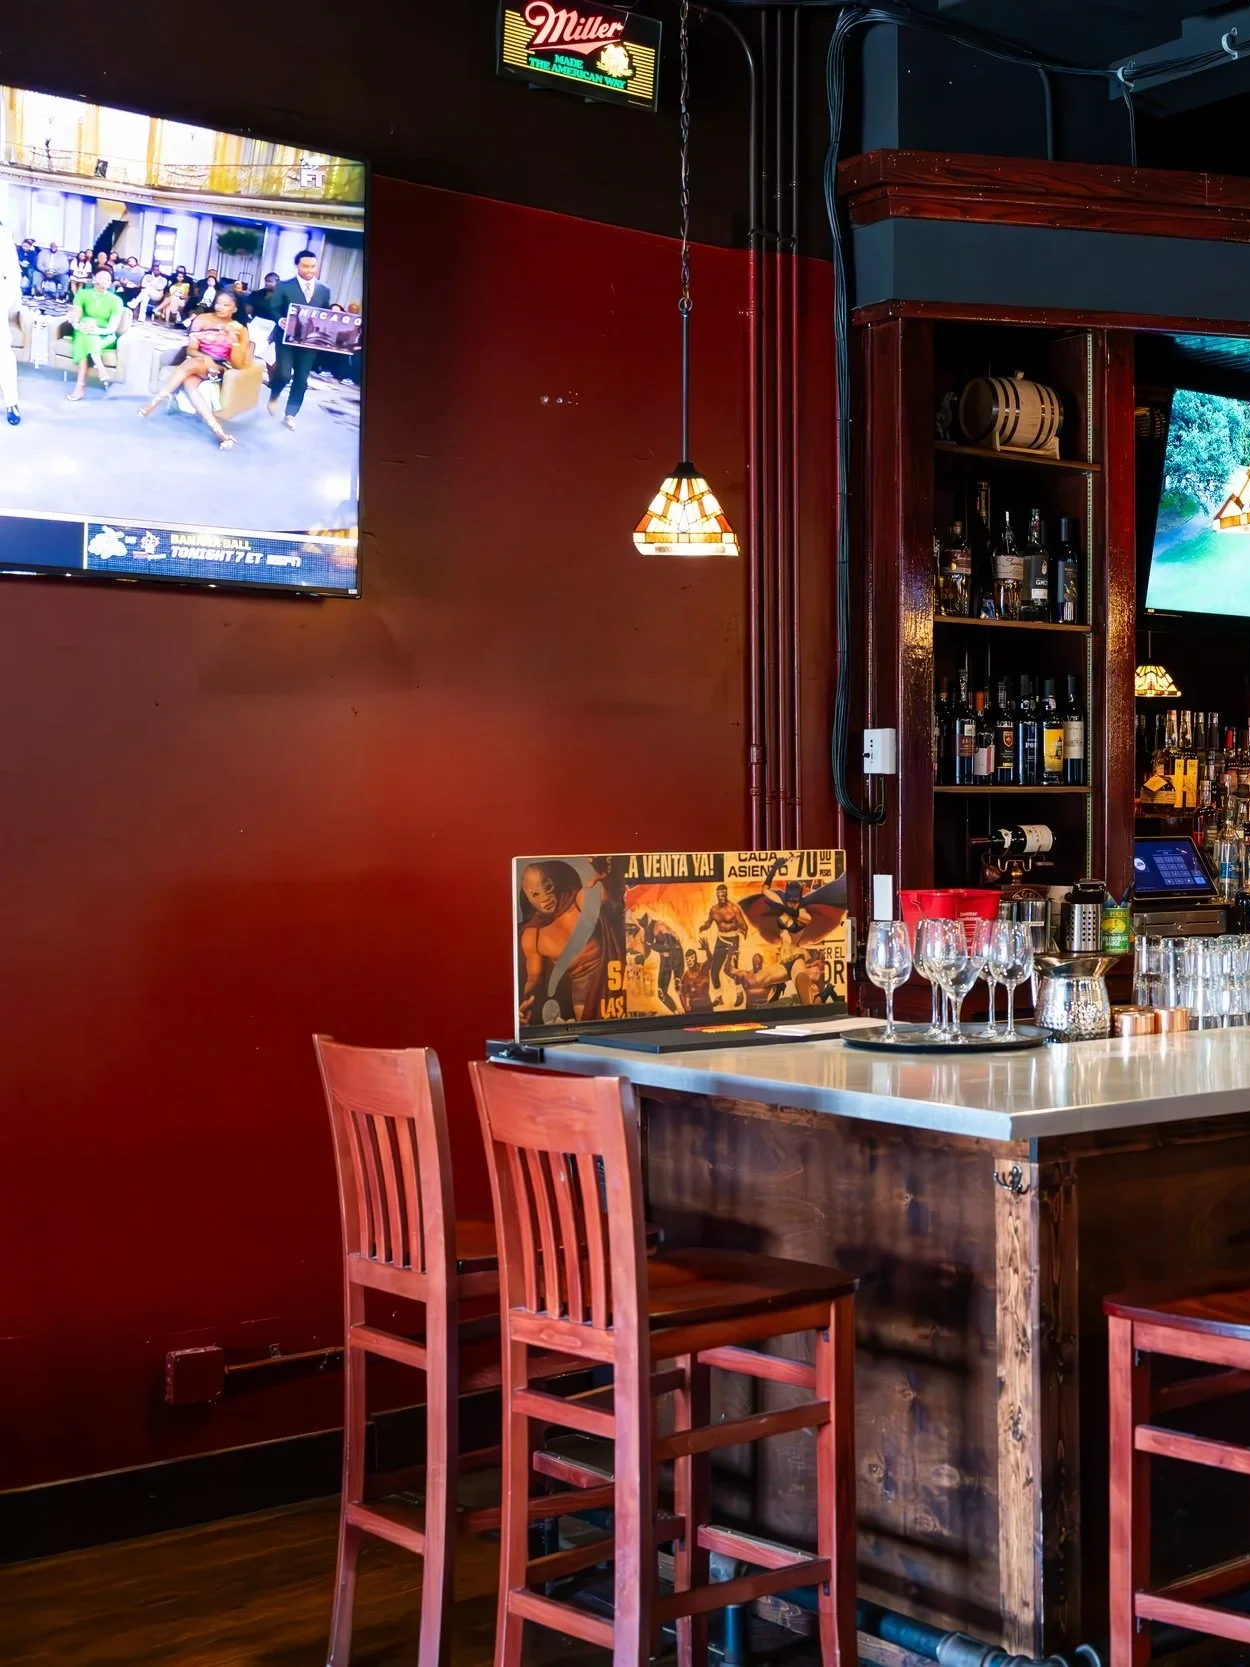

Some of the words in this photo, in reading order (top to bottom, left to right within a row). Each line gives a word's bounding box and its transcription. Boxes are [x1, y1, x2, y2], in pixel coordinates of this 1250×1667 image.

[525, 1, 624, 44] Miller
[554, 54, 583, 69] MADE
[528, 57, 551, 70] THE
[551, 63, 603, 83] AMERICAN
[604, 75, 626, 89] WAY
[289, 306, 362, 326] CHICAGO
[222, 539, 251, 550] BALL
[171, 546, 230, 563] TONIGHT
[235, 553, 244, 563] 7
[245, 553, 264, 564] ET
[642, 854, 689, 877] VENTA
[692, 854, 715, 876] YA!
[728, 865, 788, 877] ASIENO
